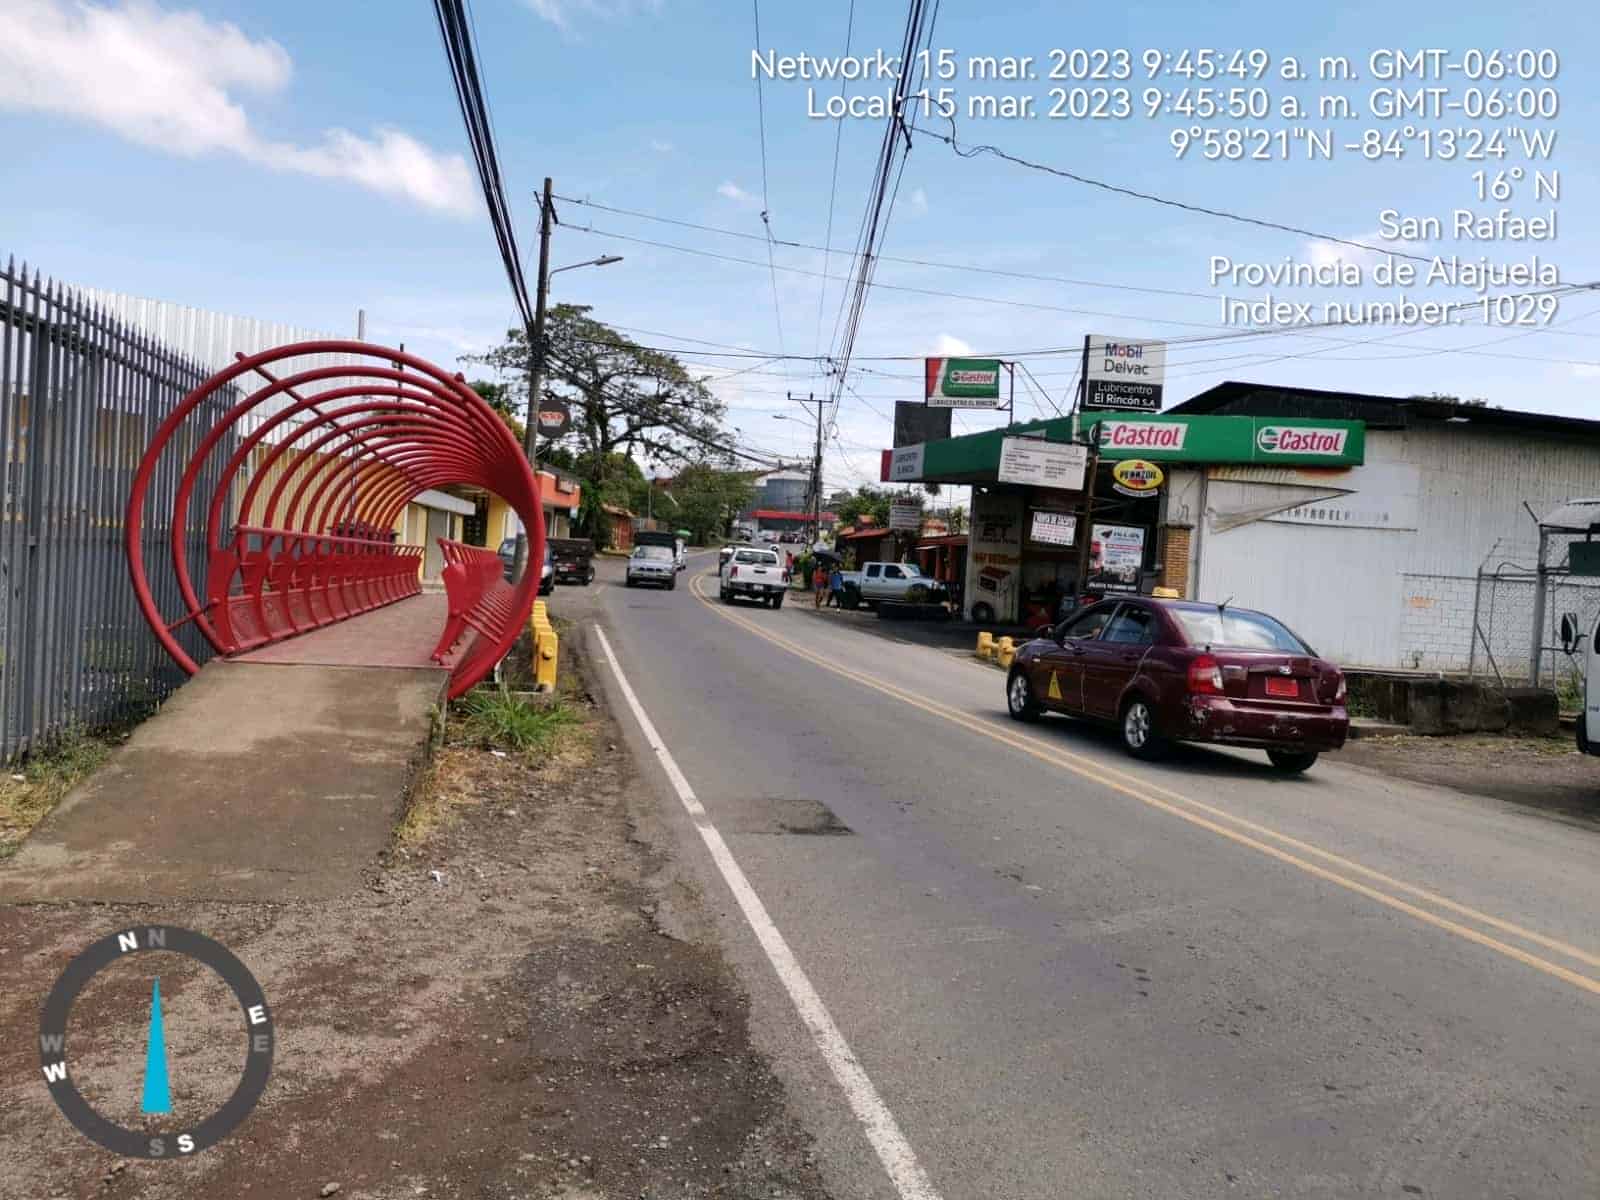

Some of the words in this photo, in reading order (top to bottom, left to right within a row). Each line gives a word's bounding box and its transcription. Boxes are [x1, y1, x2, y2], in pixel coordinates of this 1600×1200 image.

[1105, 343, 1143, 358] Mobil
[1104, 358, 1150, 375] Delvac
[1098, 383, 1153, 396] Lubricentro
[1094, 393, 1104, 403] El
[1113, 424, 1180, 446] Castrol
[1279, 430, 1341, 451] Castrol
